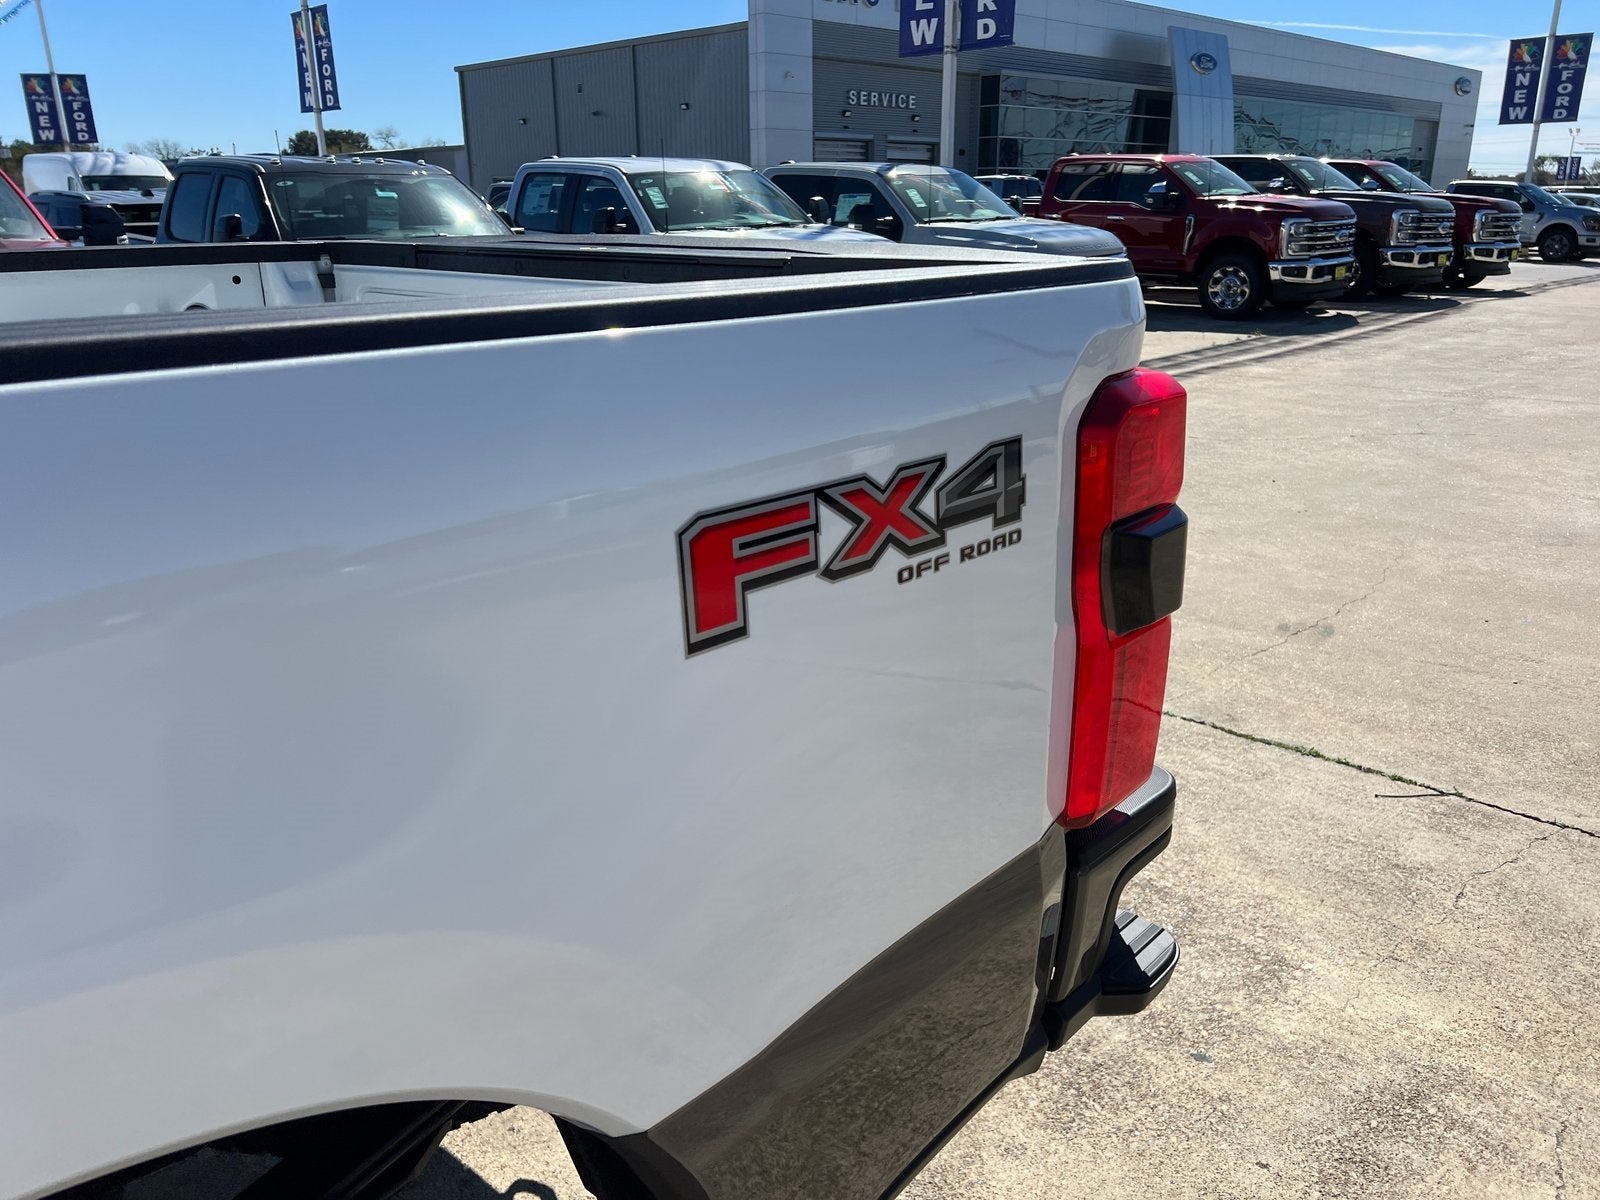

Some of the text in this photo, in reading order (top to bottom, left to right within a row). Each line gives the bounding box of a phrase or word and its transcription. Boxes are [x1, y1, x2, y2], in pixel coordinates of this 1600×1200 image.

[321, 48, 335, 106] FORD
[849, 90, 916, 109] SERVICE
[1508, 72, 1531, 120] NEW
[1552, 70, 1574, 119] FORD
[34, 101, 55, 140] NEW
[72, 101, 89, 141] FORD
[674, 434, 1026, 660] FX4
[897, 528, 1022, 585] OFF ROAD
